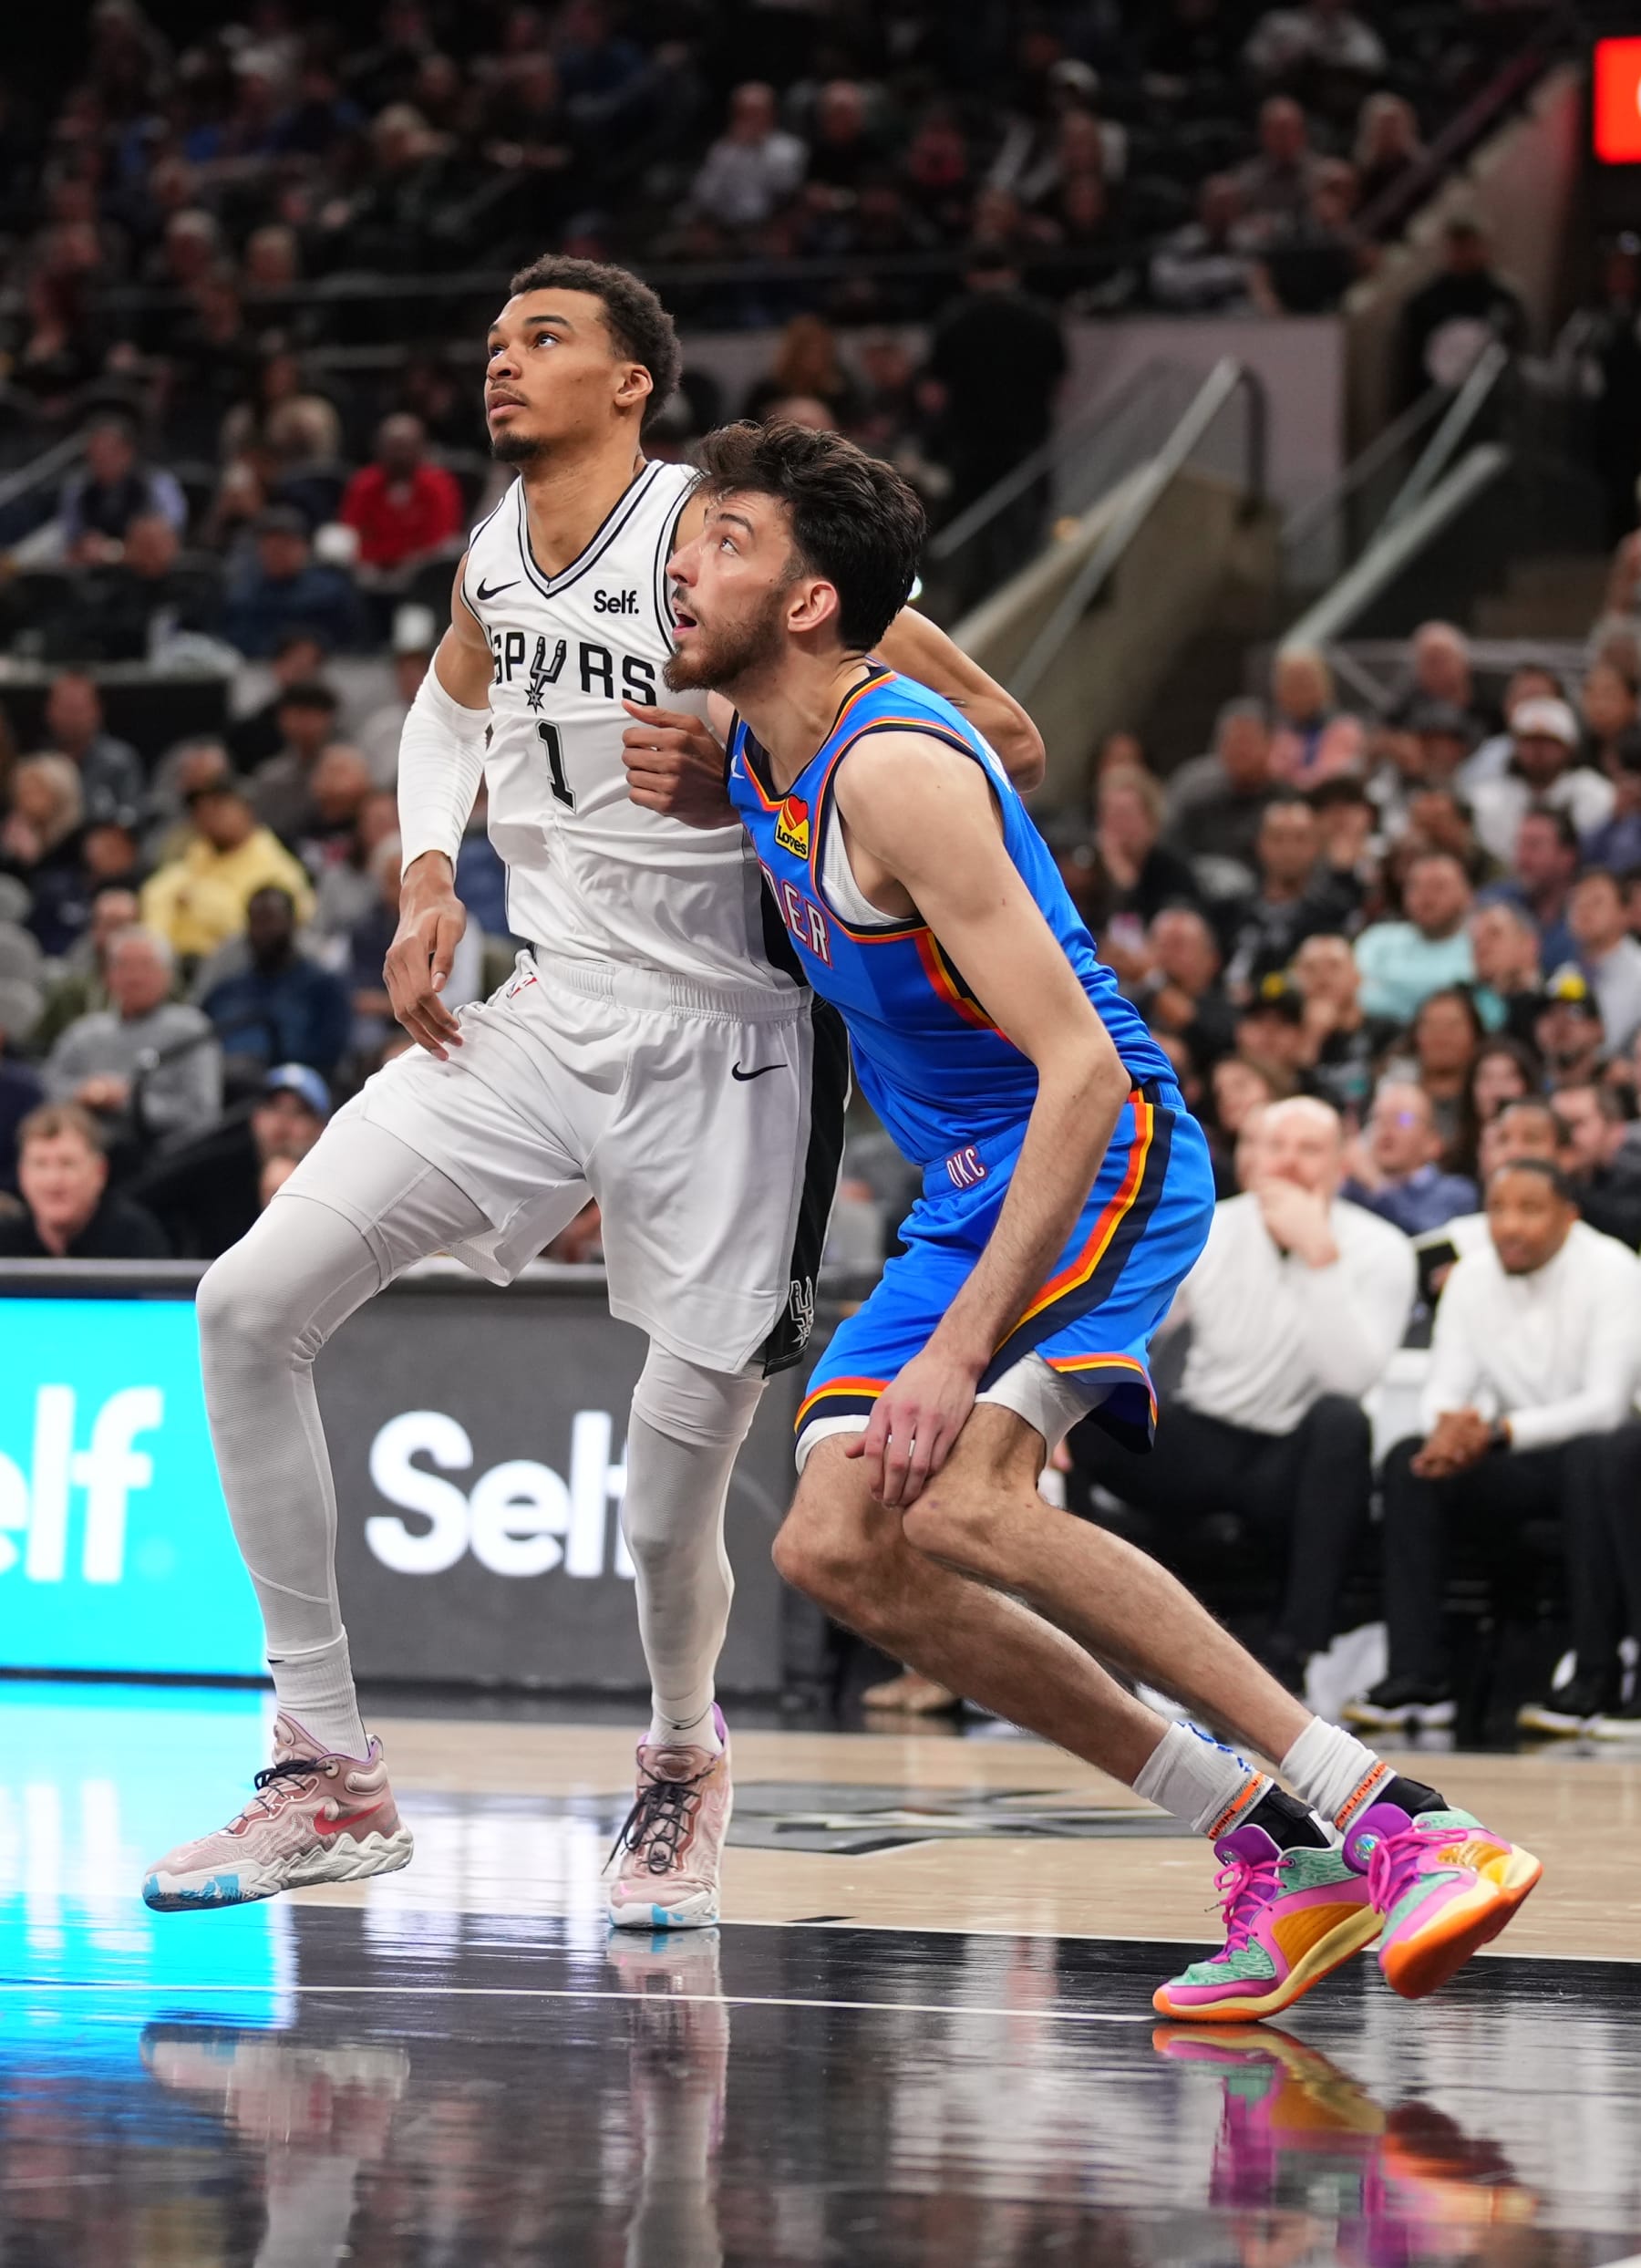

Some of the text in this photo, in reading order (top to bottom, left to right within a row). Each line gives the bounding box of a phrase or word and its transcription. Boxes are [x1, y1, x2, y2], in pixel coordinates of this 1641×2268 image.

[593, 589, 640, 615] Self.
[536, 719, 576, 813] 1
[946, 1148, 986, 1189] OKC
